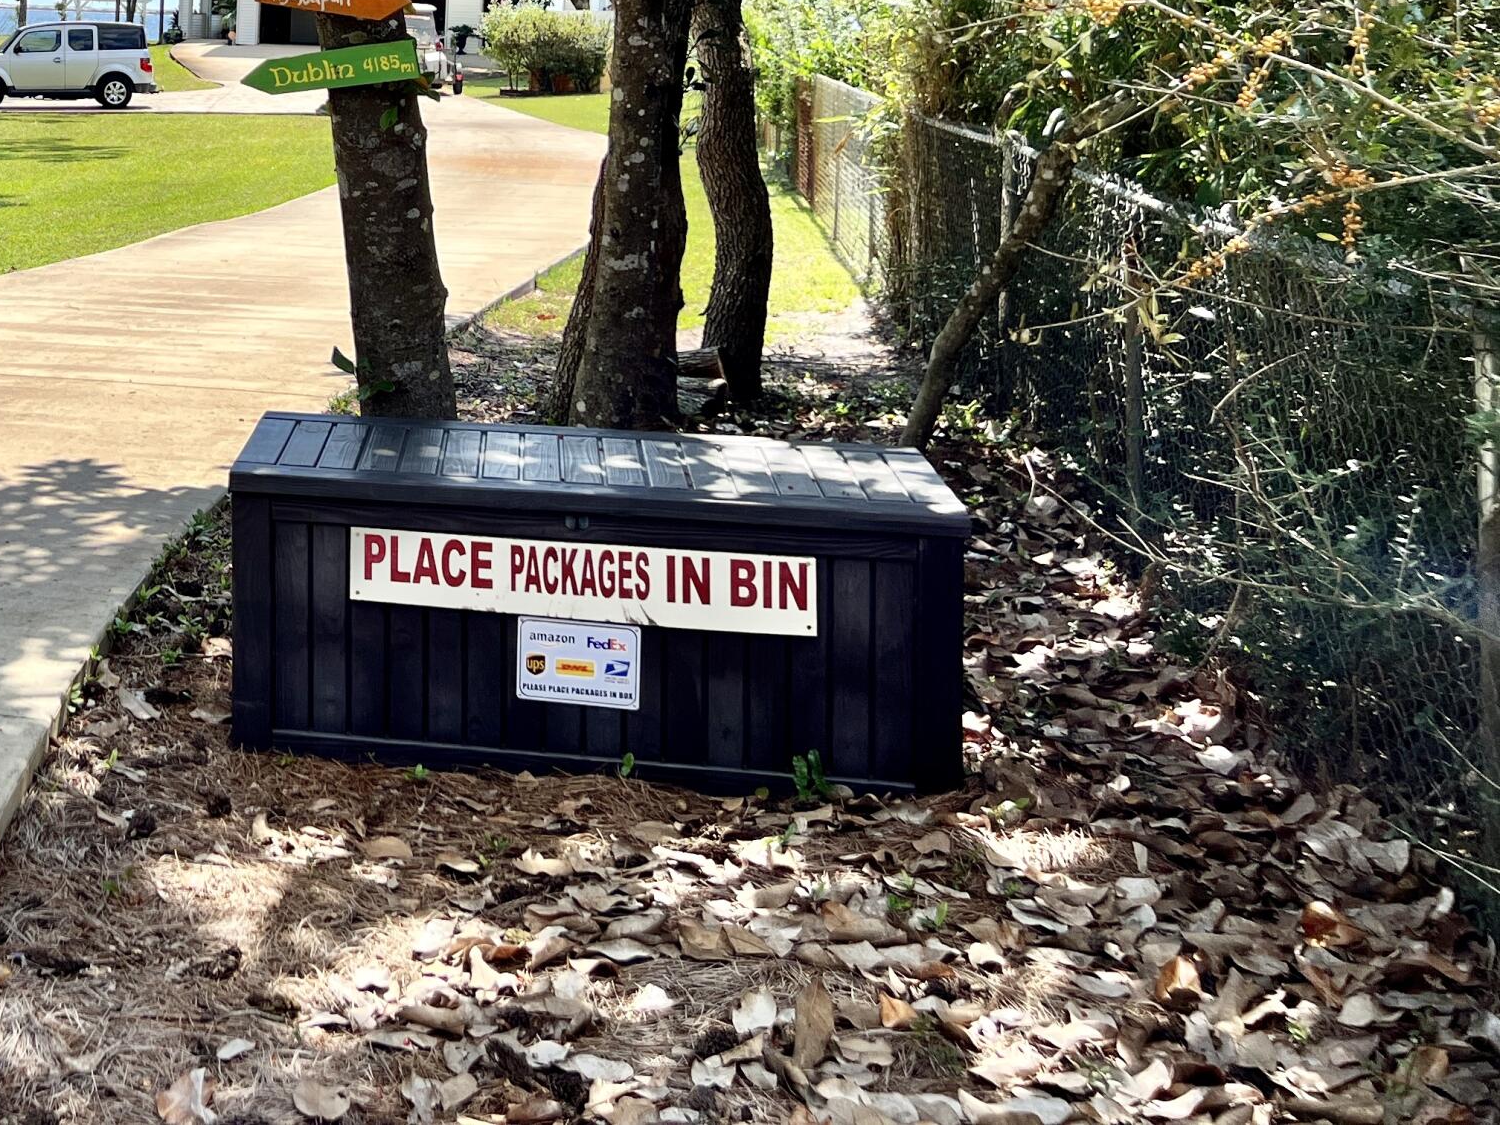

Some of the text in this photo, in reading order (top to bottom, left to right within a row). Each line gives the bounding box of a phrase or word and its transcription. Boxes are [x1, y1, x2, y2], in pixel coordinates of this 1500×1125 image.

[269, 59, 356, 87] Dublin
[363, 533, 808, 611] PLACE PACKAGES IN BIN
[529, 631, 627, 652] amazon FedEx
[527, 659, 546, 672] ups
[522, 682, 633, 700] PLEASE PLACE PACKAGES IN BOX
